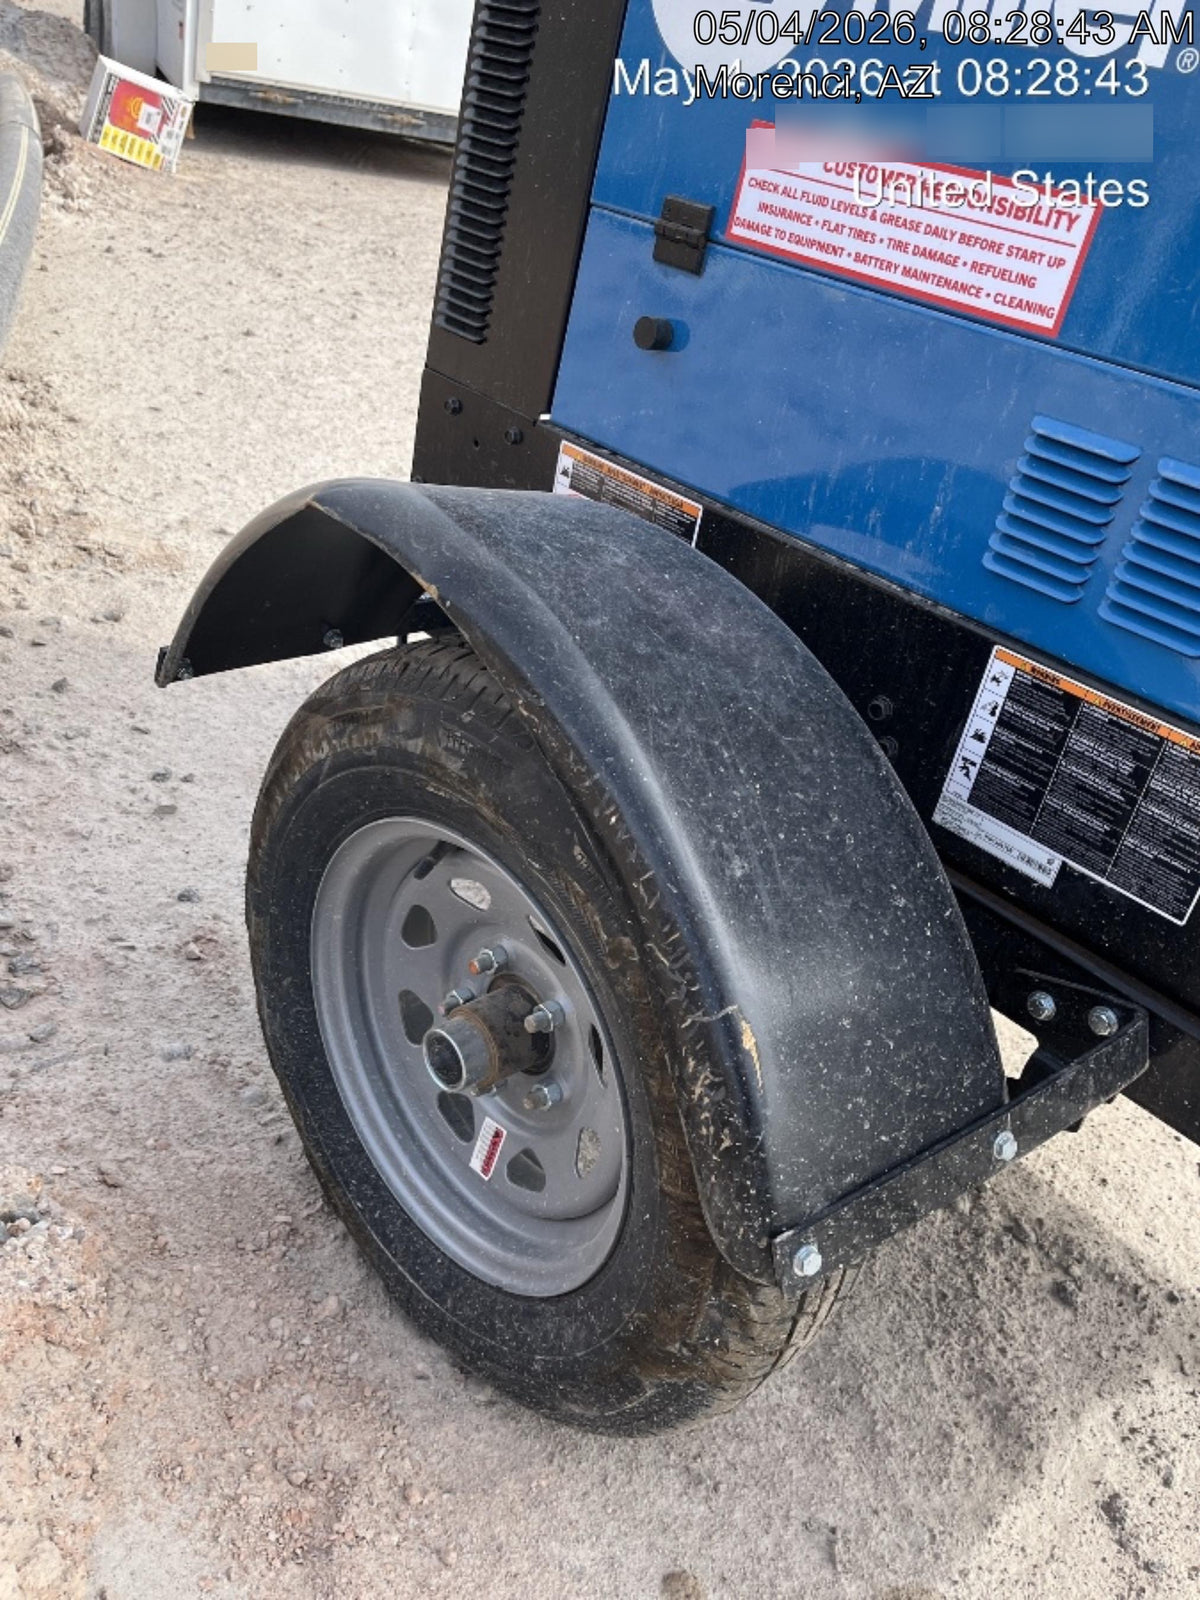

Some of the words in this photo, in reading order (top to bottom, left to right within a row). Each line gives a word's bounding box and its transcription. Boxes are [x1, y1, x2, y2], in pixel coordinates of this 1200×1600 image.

[733, 216, 772, 237] DAMAGE
[774, 227, 786, 241] TO
[787, 232, 845, 259] EQUIPMENT
[852, 252, 901, 275] BATTERY
[901, 265, 984, 299] MAINTENANCE
[993, 292, 1057, 319] CLEANING
[748, 177, 780, 194] CHECK
[781, 185, 798, 199] ALL
[800, 191, 829, 208] FLUID
[831, 198, 868, 219] LEVELS
[869, 209, 878, 221] &
[879, 212, 921, 234] GREASE
[924, 223, 957, 242] DAILY
[958, 232, 1006, 255] BEFORE
[1006, 245, 1046, 266] START
[1047, 256, 1067, 270] UP
[757, 201, 813, 227] INSURANCE
[821, 219, 847, 236] FLAT
[847, 227, 877, 245] TIRES
[886, 237, 911, 253] TIRE
[912, 244, 961, 267] DAMAGE
[969, 260, 1038, 289] REFUELING
